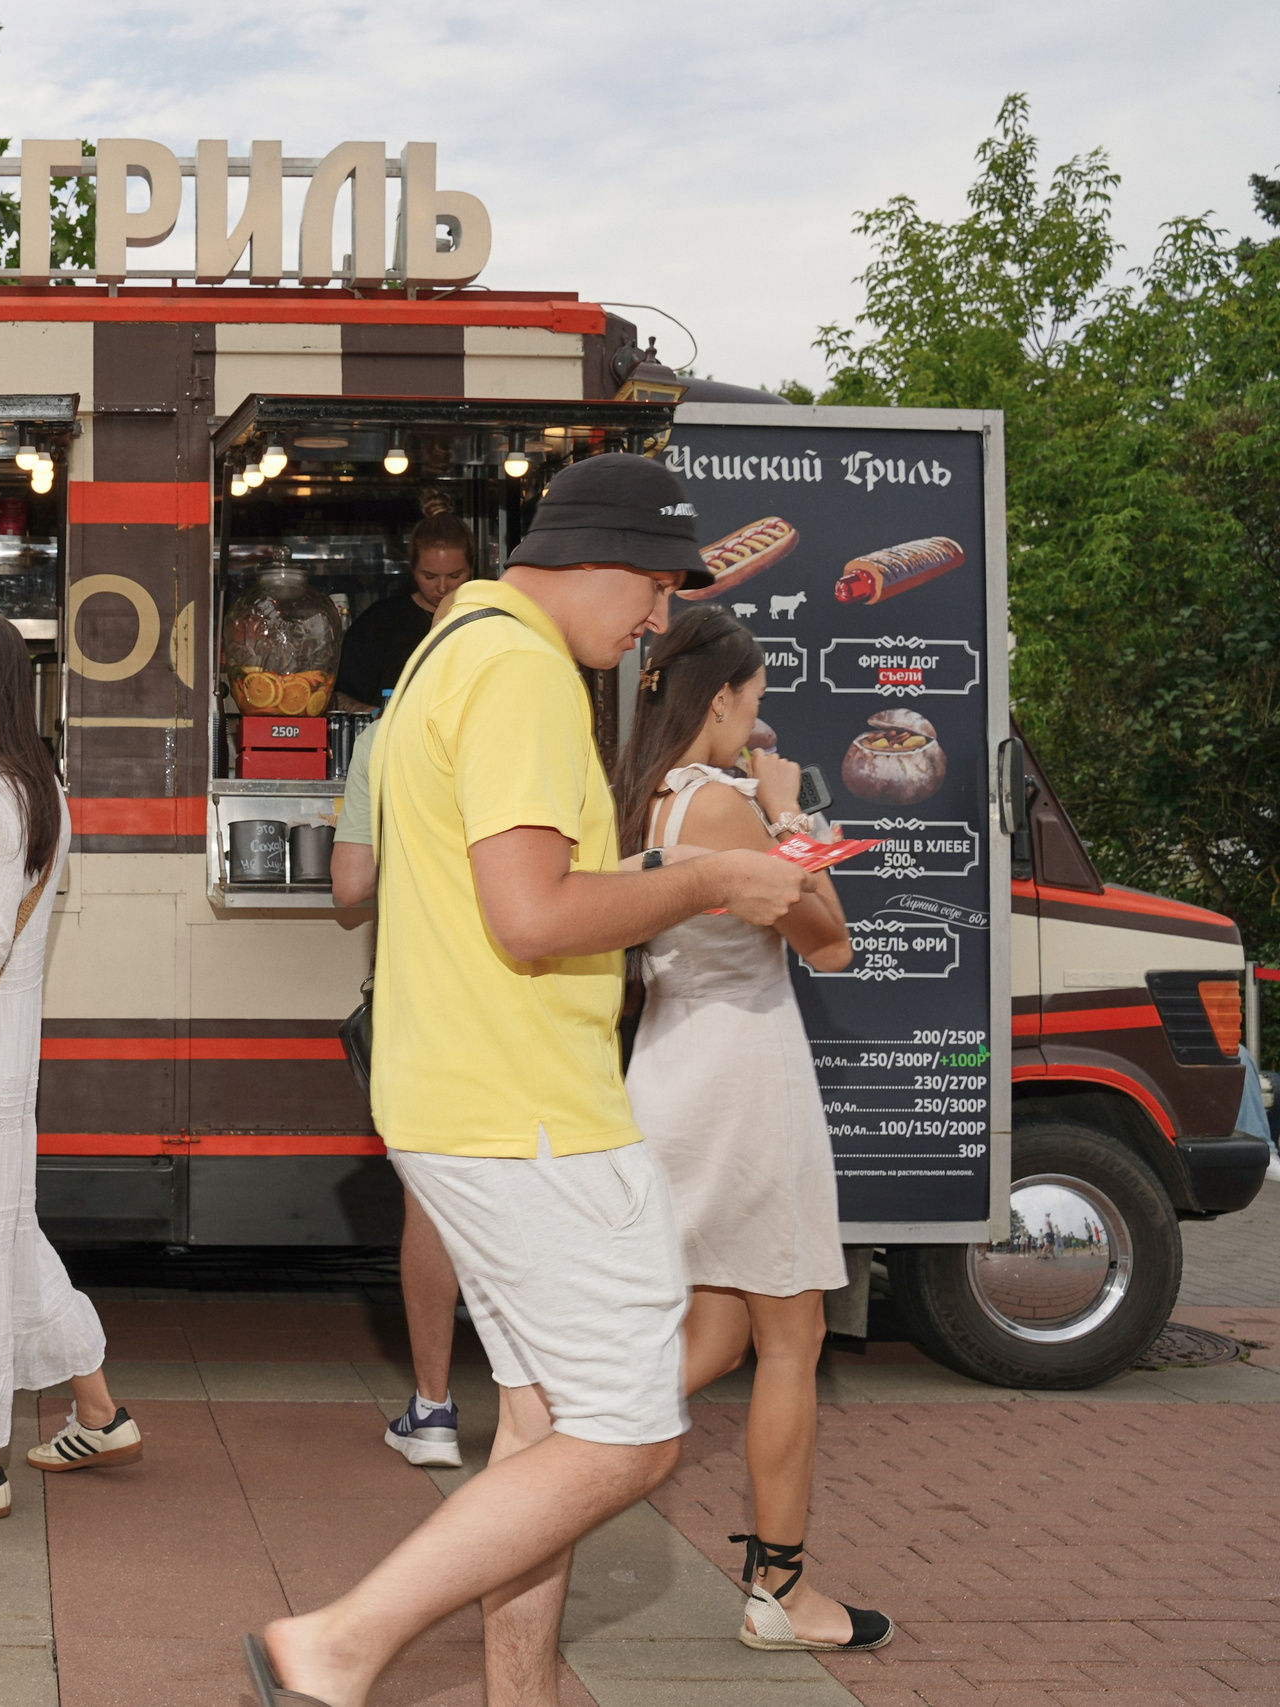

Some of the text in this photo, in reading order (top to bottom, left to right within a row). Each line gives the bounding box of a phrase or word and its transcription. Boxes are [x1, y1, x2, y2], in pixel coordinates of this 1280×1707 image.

[20, 138, 492, 287] ГРИЛЬ
[664, 445, 952, 491] Чешский Гриль
[764, 652, 799, 667] ИЛЬ
[858, 654, 940, 669] ФРЕНЧ ДОГ
[879, 670, 922, 682] съели
[272, 726, 299, 738] 250Р
[868, 839, 971, 853] ЛЯШ В ХЛЕБЕ
[940, 906, 962, 920] соус
[850, 937, 947, 952] ОФЕЛЬ ФРИ
[912, 1029, 986, 1047] 200/250Р
[914, 1074, 987, 1092] 230/270Р
[914, 1097, 987, 1115] 250/300Р
[958, 1144, 987, 1158] 30Р
